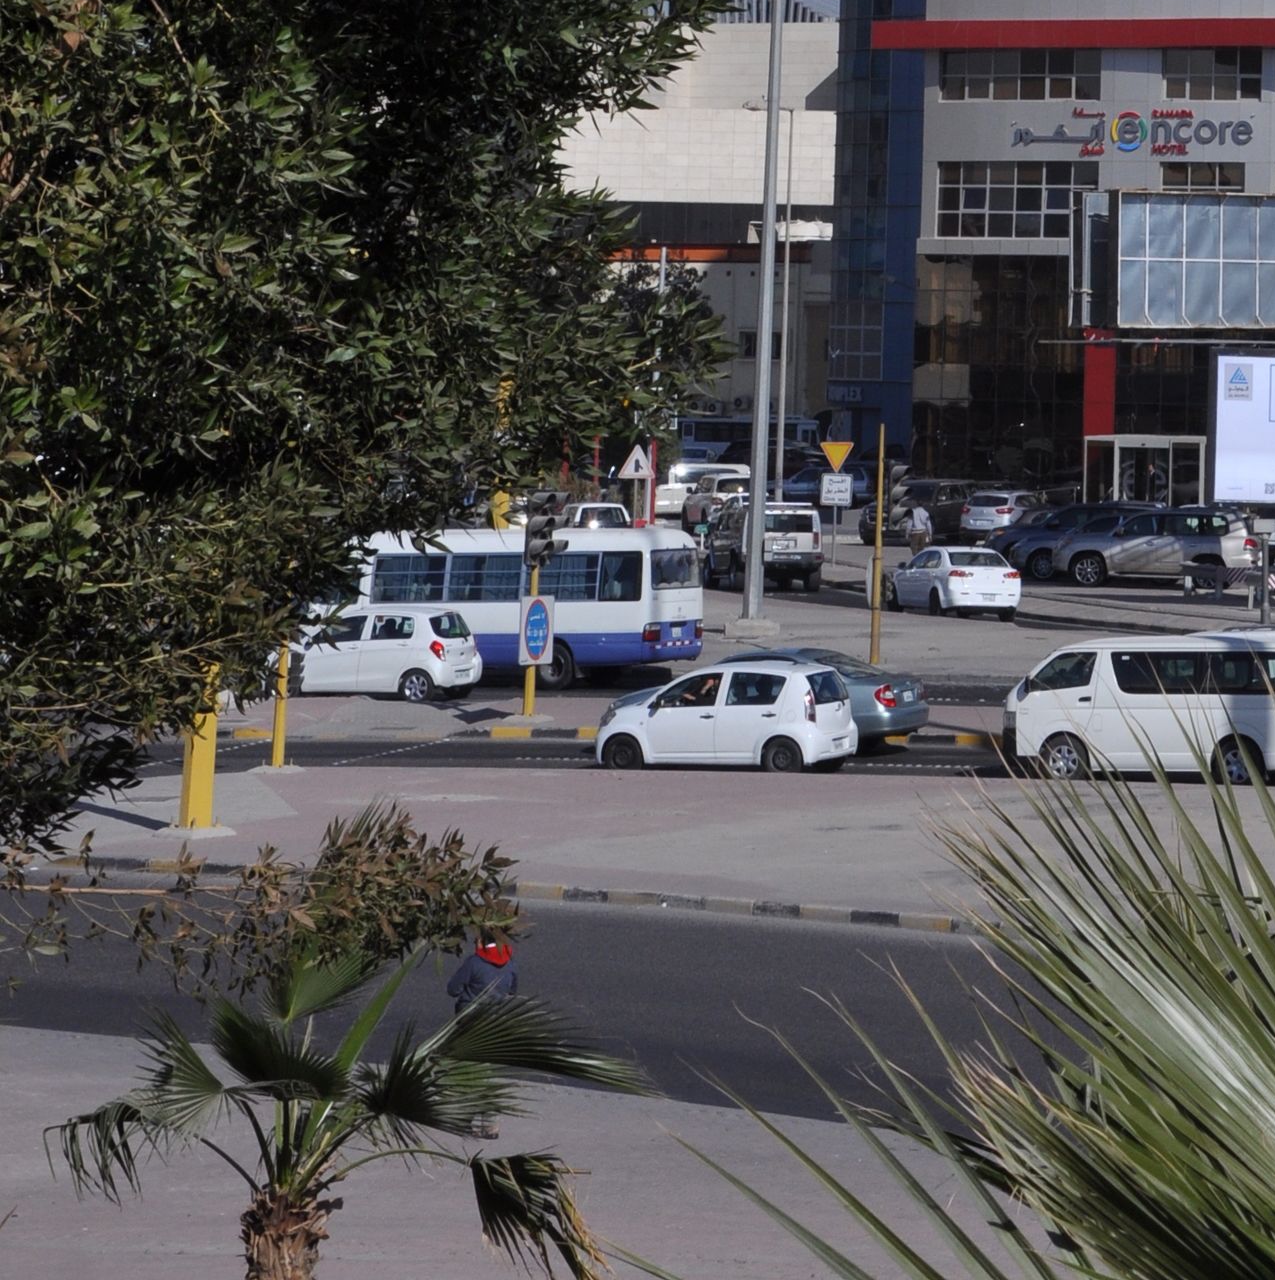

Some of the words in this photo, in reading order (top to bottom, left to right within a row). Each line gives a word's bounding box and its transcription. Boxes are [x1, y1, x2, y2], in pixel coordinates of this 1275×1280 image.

[1151, 109, 1194, 119] RAMADA
[1112, 114, 1254, 149] encore
[1151, 144, 1188, 155] HOTEL
